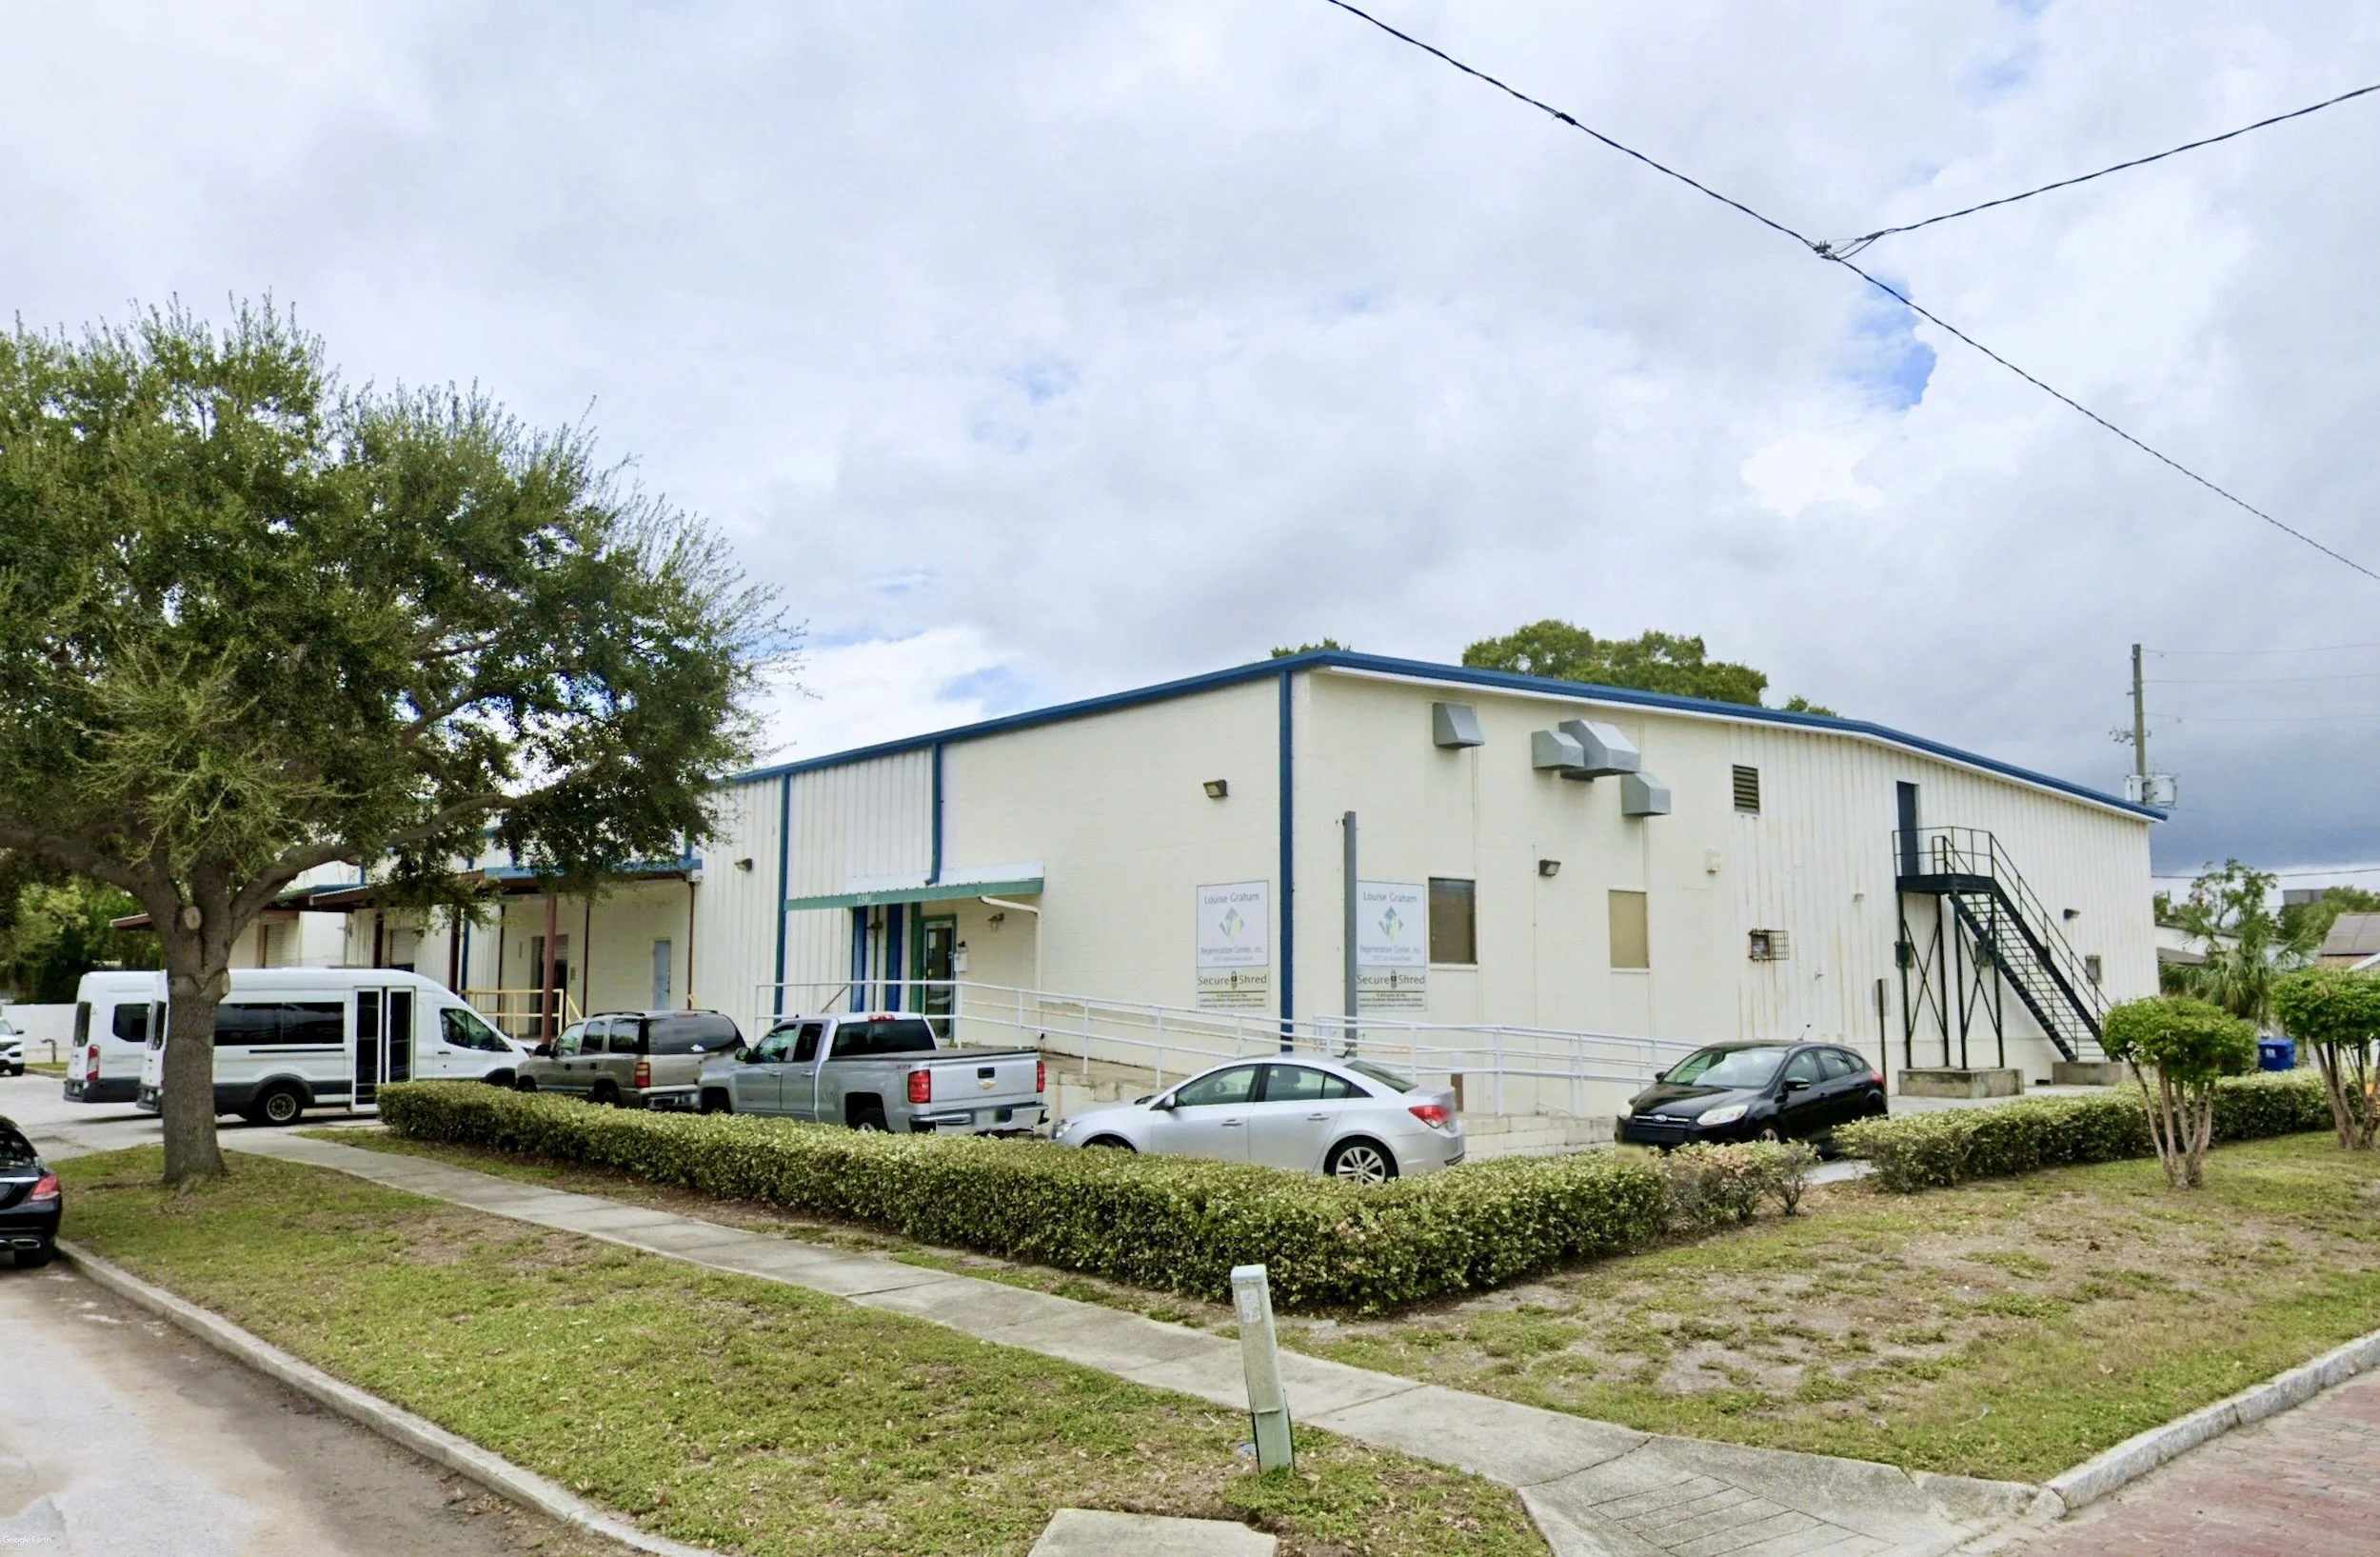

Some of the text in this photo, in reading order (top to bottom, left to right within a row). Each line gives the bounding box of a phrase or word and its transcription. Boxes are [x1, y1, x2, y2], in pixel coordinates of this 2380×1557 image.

[1204, 891, 1260, 905] Louise Graham
[1362, 891, 1418, 904] Louise Graham
[1198, 974, 1267, 987] Secure Shred
[1357, 974, 1425, 985] Secure Shred
